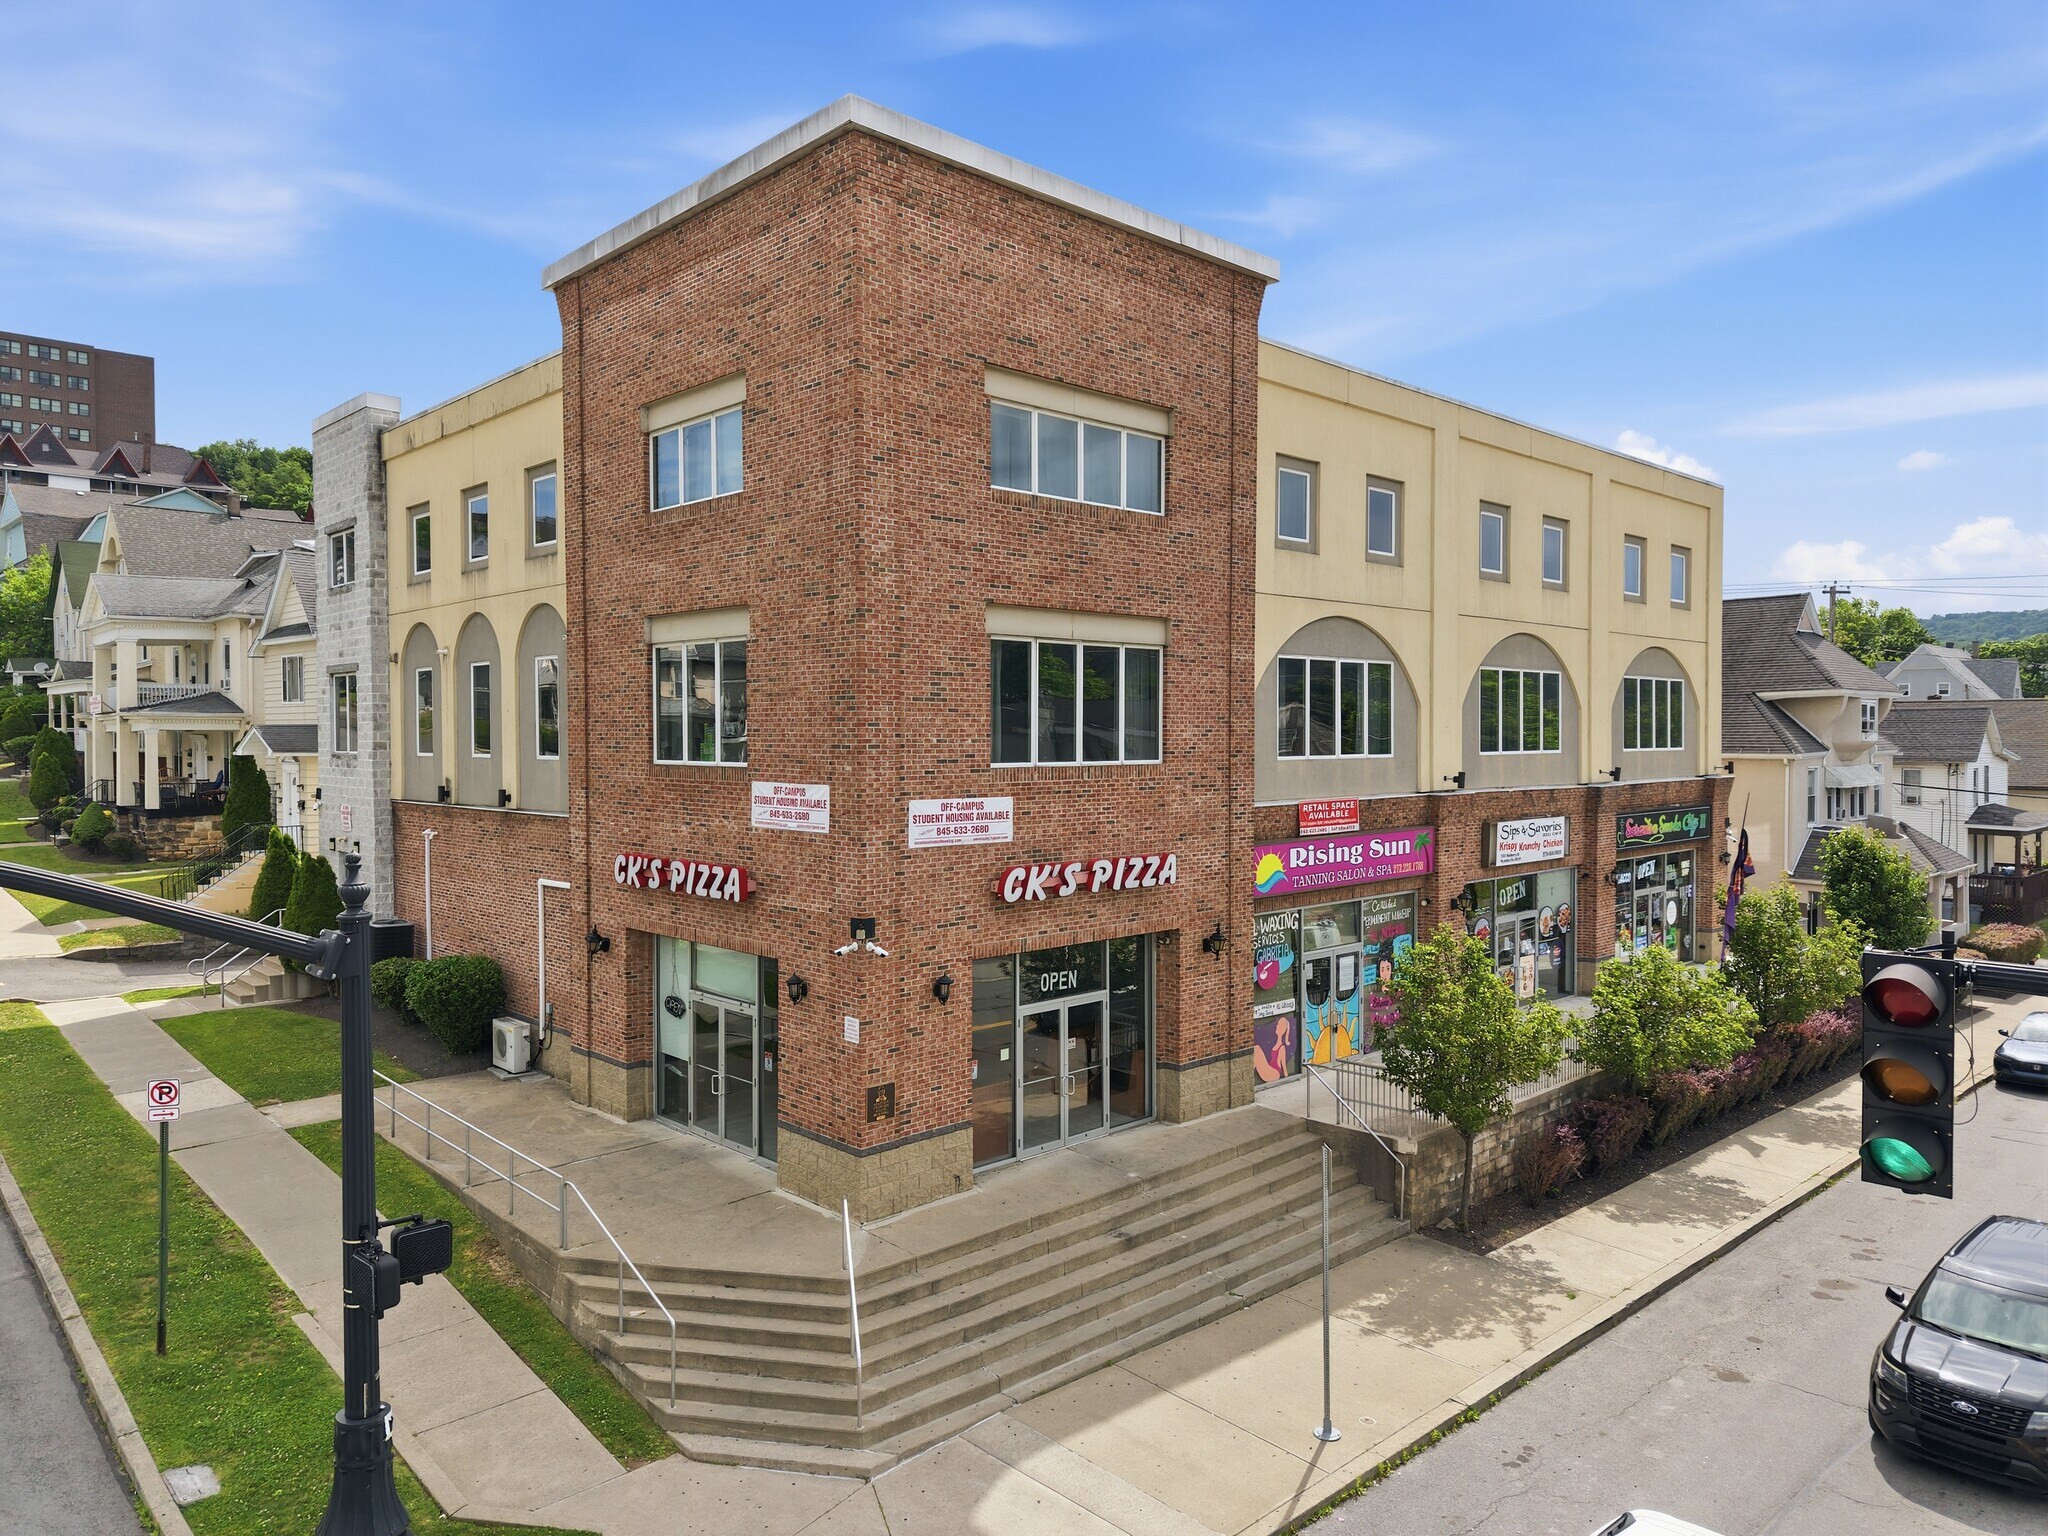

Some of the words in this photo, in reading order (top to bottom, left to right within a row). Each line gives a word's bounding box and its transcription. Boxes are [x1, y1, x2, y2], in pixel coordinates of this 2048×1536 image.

[773, 786, 807, 797] OFF-CAMPUS
[753, 795, 776, 806] STUDENT
[776, 797, 798, 807] HOUSING
[799, 798, 827, 809] AVAILABLE
[940, 801, 985, 812] OFF-CAMPUS
[1303, 803, 1330, 812] RETAIL
[1331, 801, 1355, 810] SPACE
[912, 814, 944, 824] STUDENT
[945, 812, 974, 823] HOUSING
[975, 811, 1010, 821] AVAILABLE
[1308, 810, 1350, 820] AVAILABLE
[1500, 824, 1520, 840] Sips
[1521, 825, 1528, 836] &
[1527, 821, 1562, 837] Savories
[1289, 842, 1364, 869] Rising
[1368, 838, 1411, 859] Sun
[1499, 841, 1518, 852] Krispy
[1519, 841, 1541, 851] Krunchy
[1543, 839, 1563, 849] Chicken
[614, 854, 662, 890] CK'S
[670, 860, 741, 903] PIZZA
[1003, 862, 1082, 903] CK'S
[1091, 853, 1178, 893] PIZZA
[1292, 871, 1335, 888] TANNING
[1337, 867, 1367, 882] SALON
[1368, 866, 1375, 878] &
[1376, 864, 1392, 876] SPA
[1637, 859, 1656, 880] OPEN
[1499, 880, 1526, 906] OPEN
[1260, 911, 1299, 934] WAXING
[1253, 931, 1285, 949] SERVICES
[1040, 969, 1078, 992] OPEN
[665, 997, 685, 1015] OPEN
